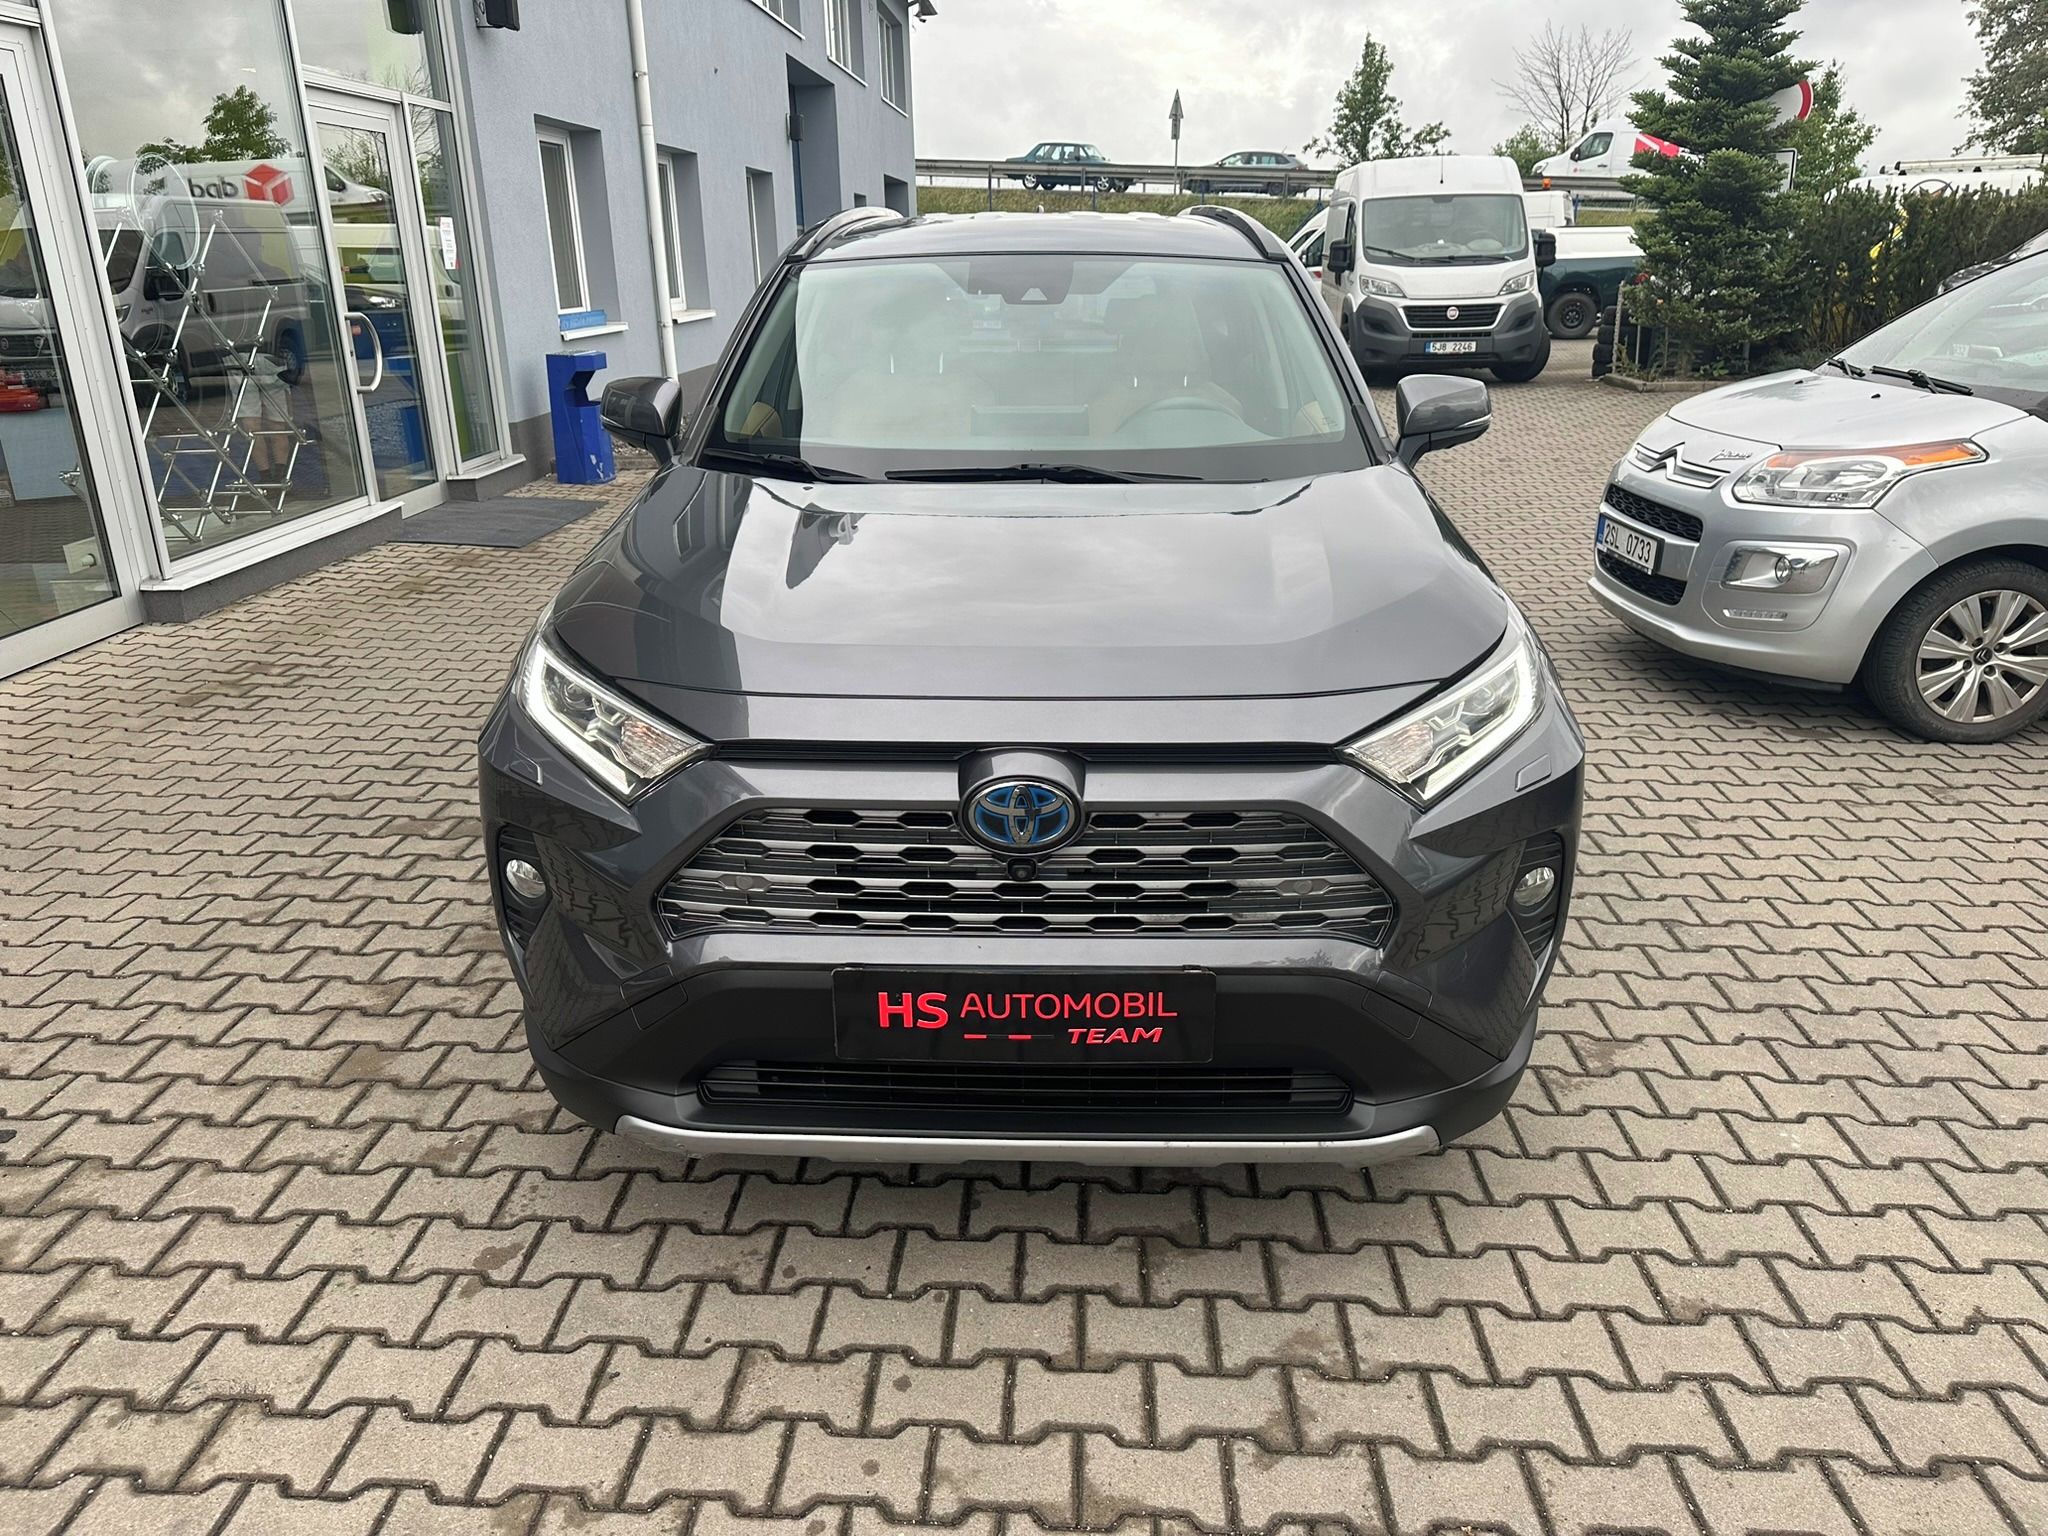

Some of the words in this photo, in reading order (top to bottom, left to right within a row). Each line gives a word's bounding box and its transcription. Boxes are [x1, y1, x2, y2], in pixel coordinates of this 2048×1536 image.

[1452, 342, 1473, 351] 2246
[1604, 523, 1619, 550] 2SL
[1626, 533, 1652, 563] 0733
[877, 991, 949, 1029] HS
[959, 991, 1178, 1019] AUTOMOBIL
[1067, 1027, 1163, 1045] TEAM
